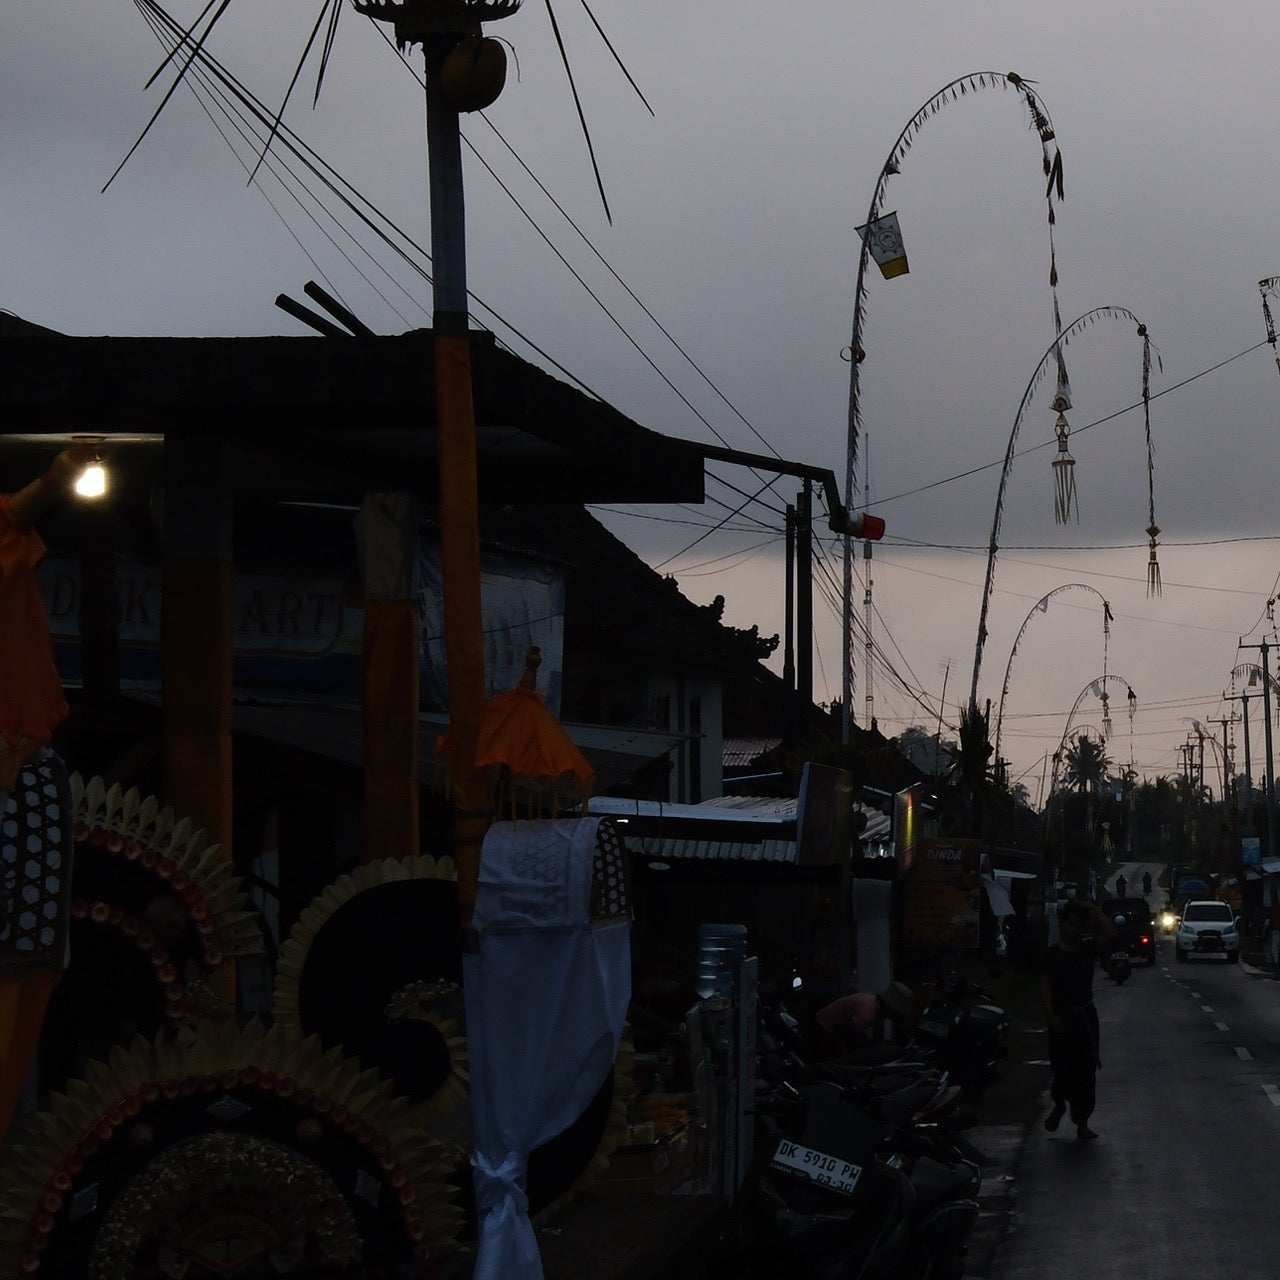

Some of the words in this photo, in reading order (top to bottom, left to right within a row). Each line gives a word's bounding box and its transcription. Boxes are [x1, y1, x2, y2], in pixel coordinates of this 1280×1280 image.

[238, 587, 335, 636] ART
[779, 1142, 799, 1158] DK
[841, 1164, 860, 1180] PH
